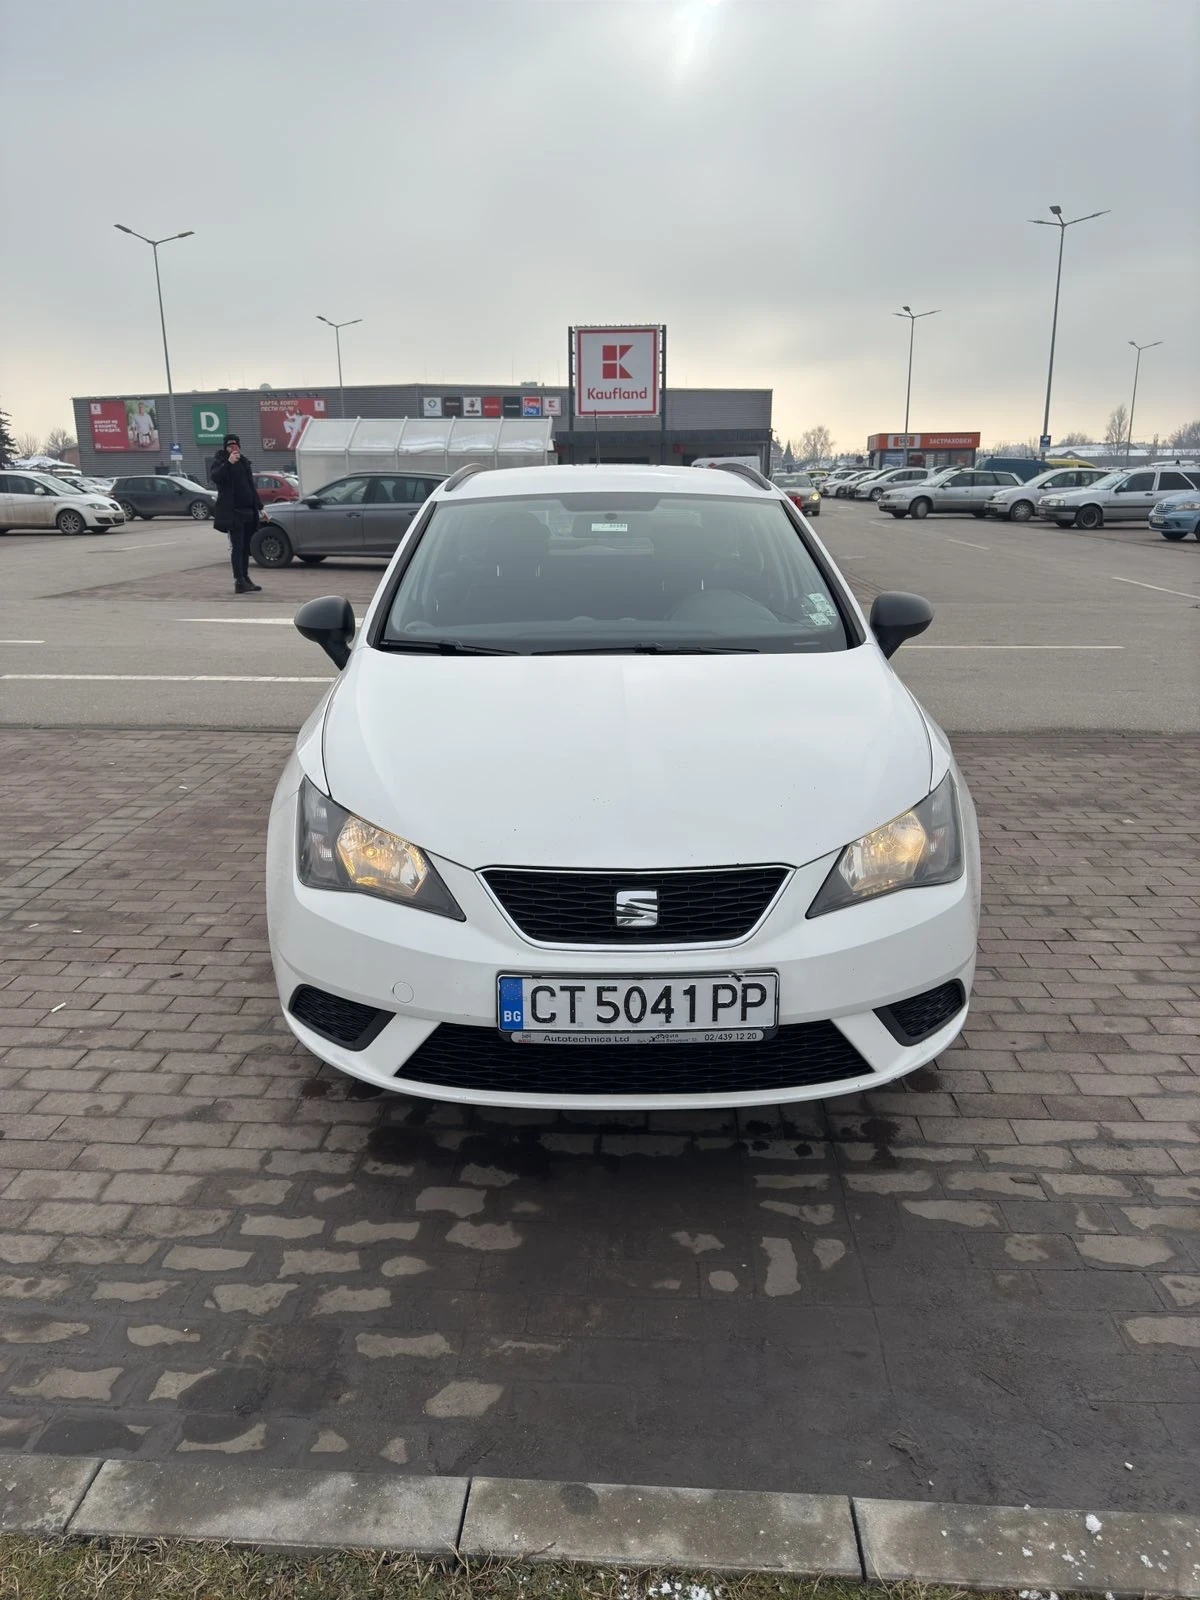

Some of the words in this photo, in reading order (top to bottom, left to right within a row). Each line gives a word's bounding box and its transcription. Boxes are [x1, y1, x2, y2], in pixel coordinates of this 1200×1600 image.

[587, 386, 648, 400] Kaufland
[928, 437, 973, 445] ЗАСТРАХОВКИ
[596, 985, 697, 1024] 5041
[504, 1010, 522, 1023] BG
[543, 1034, 612, 1043] Autotechnica
[614, 1035, 630, 1043] Ltd
[704, 1033, 733, 1041] 02/439
[736, 1032, 745, 1040] 12
[747, 1032, 757, 1040] 20
